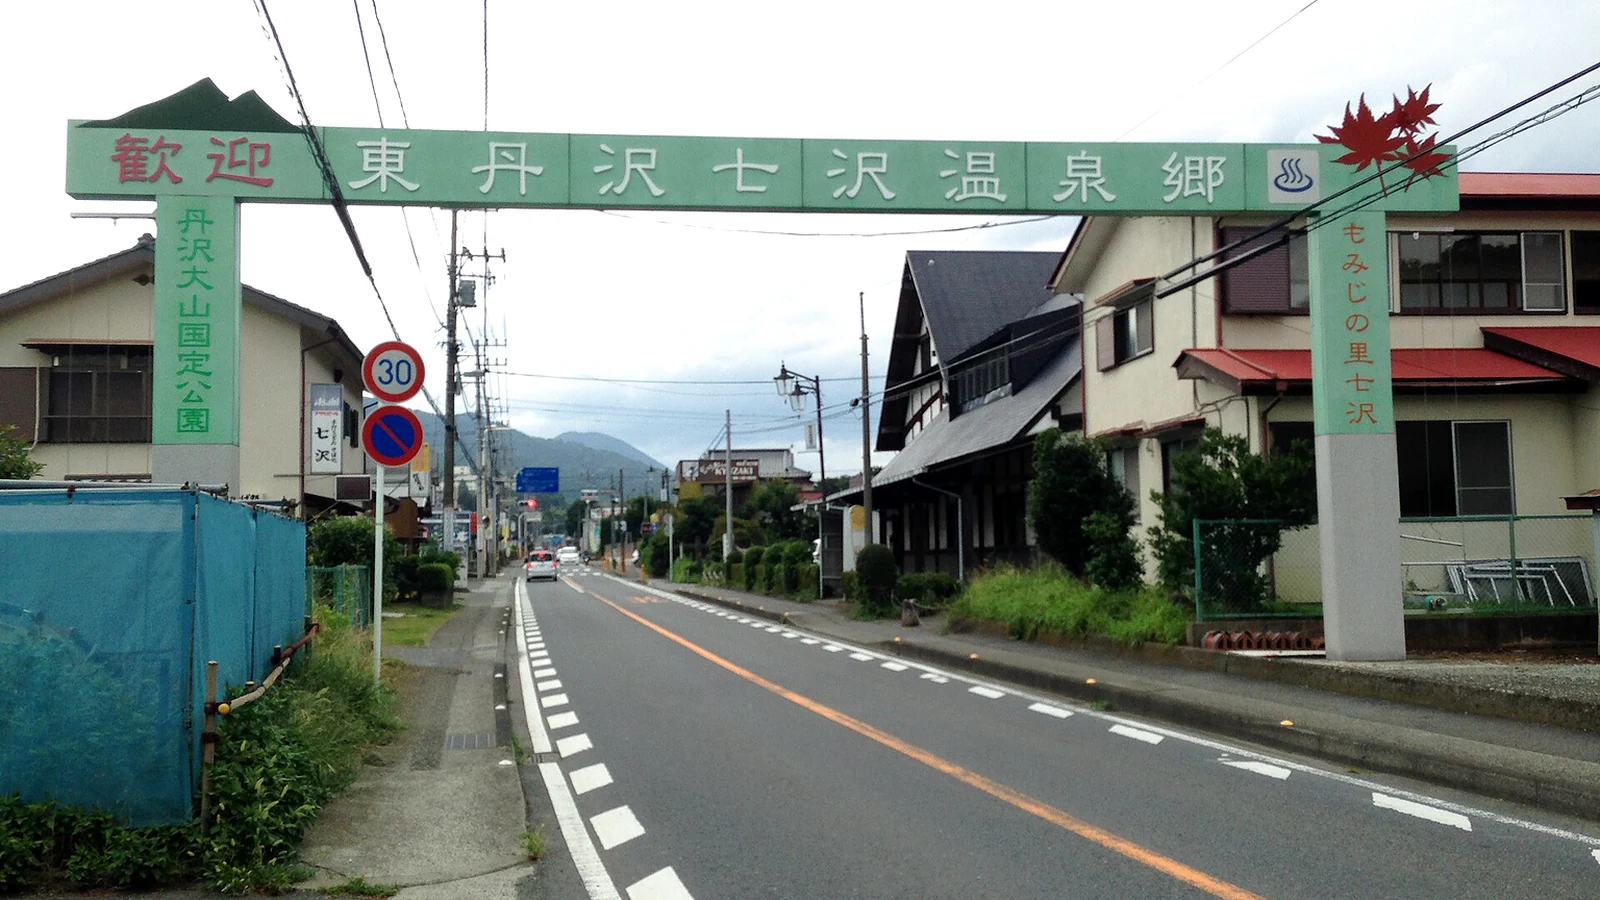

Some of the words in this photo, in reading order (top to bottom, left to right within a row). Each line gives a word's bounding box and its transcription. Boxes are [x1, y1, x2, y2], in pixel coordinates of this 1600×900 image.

[111, 133, 273, 187] 歓迎
[348, 137, 1227, 203] 東丹沢七沢温泉郷
[176, 209, 214, 433] 丹沢大山国定公園
[1342, 222, 1378, 424] もみじの里七沢
[378, 359, 411, 385] 30
[314, 427, 331, 462] 七沢
